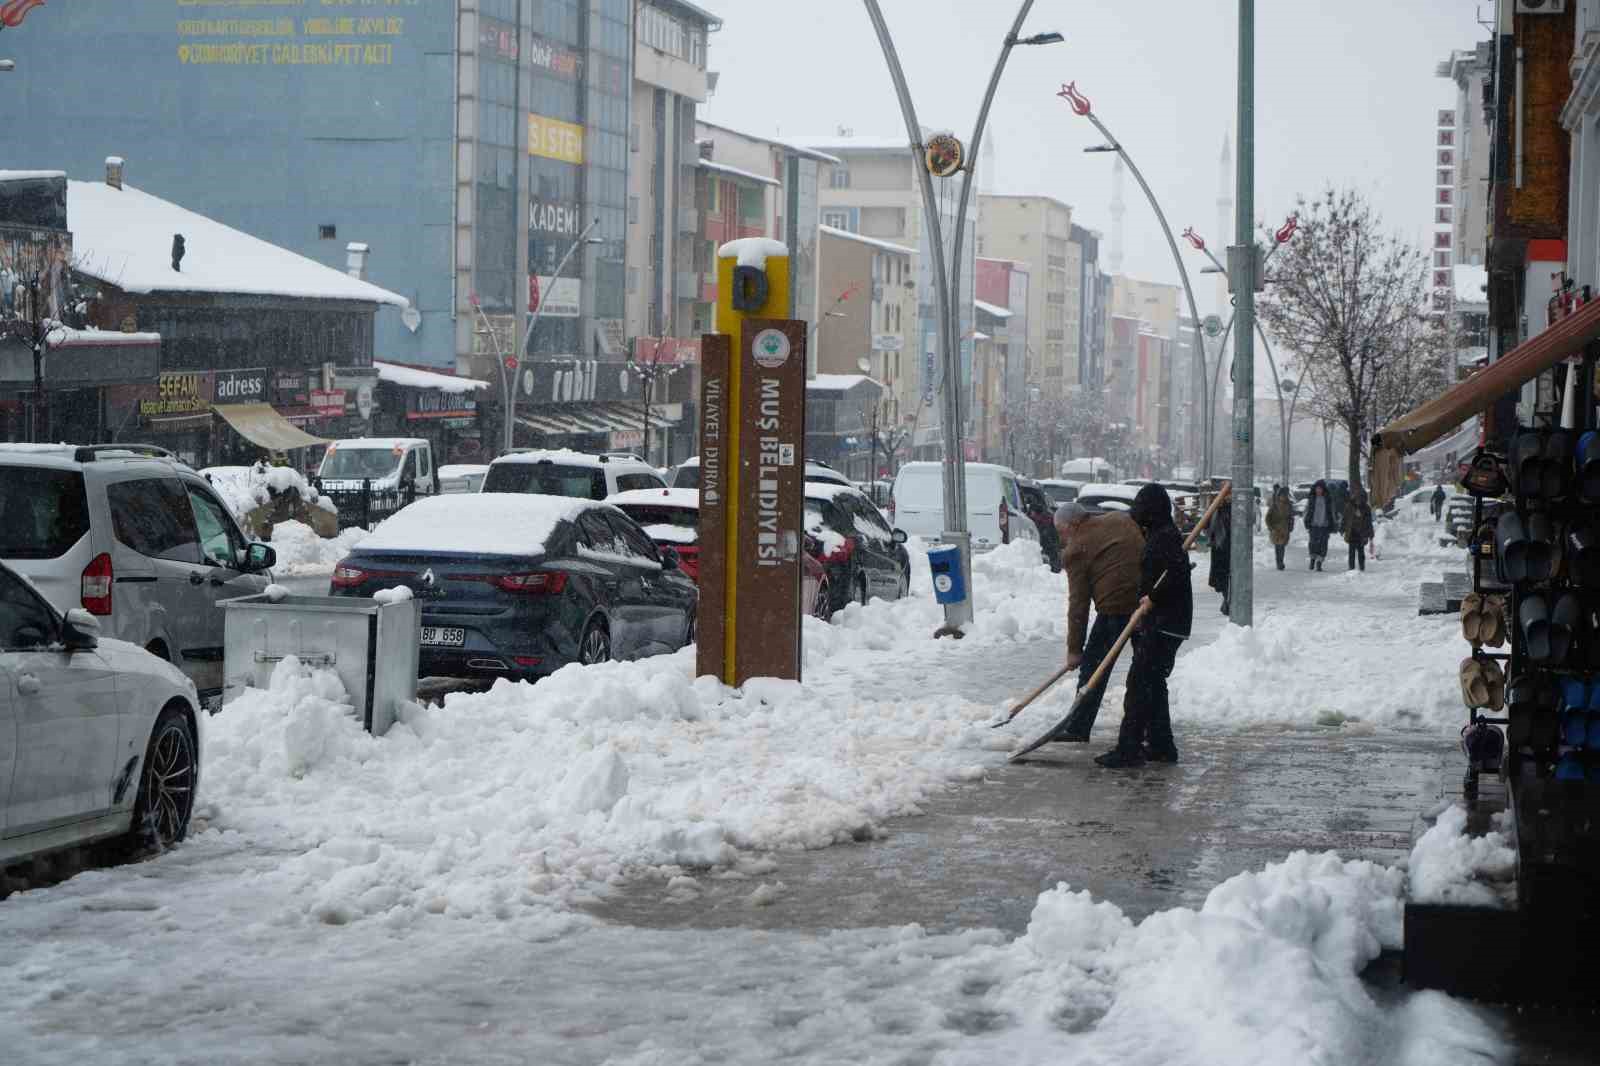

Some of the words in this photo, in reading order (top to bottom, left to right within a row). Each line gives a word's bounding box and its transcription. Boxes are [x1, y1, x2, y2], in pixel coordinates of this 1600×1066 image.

[1437, 129, 1451, 224] HOTEL
[529, 201, 579, 234] KADEMİ
[732, 264, 768, 311] D
[218, 374, 262, 397] adress
[755, 378, 780, 430] MUŞ
[758, 436, 781, 566] BELDİYSİ
[443, 629, 462, 641] 658
